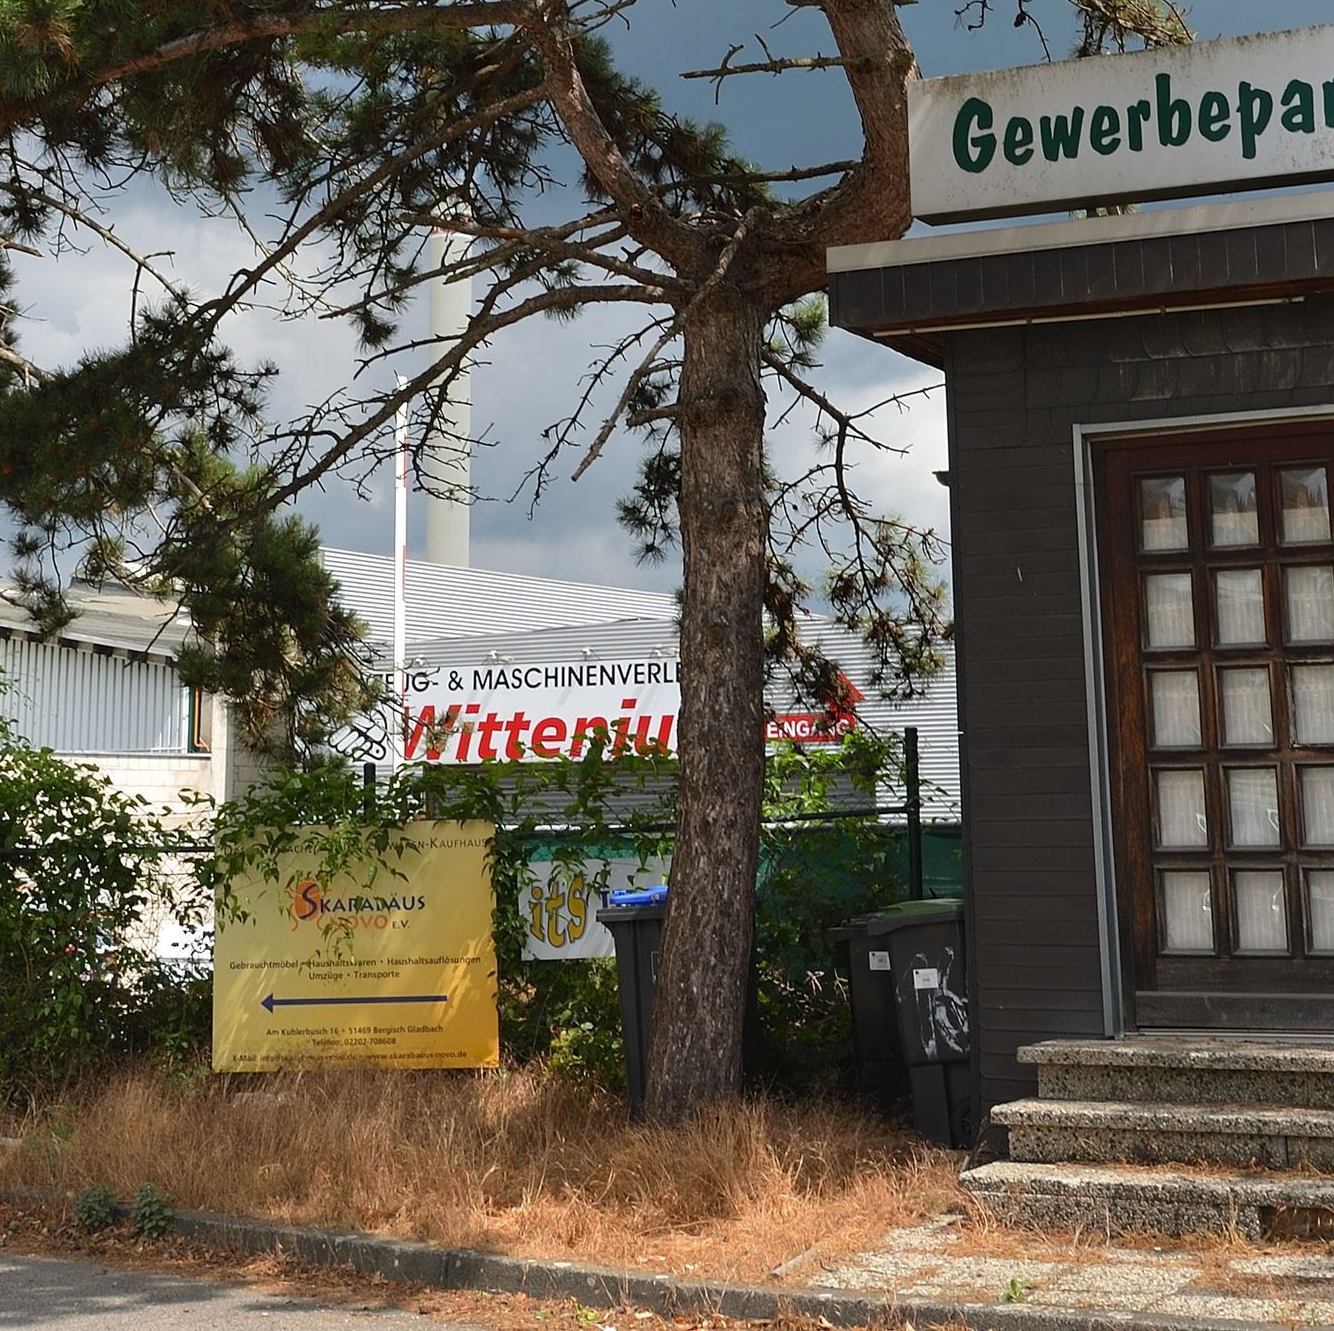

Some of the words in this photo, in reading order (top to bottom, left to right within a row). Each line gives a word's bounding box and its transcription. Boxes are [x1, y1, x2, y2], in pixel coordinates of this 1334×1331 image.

[448, 671, 464, 691] &
[402, 698, 679, 761] Witteniu
[354, 970, 401, 980] Transporte
[266, 1028, 280, 1036] Am
[330, 1027, 339, 1035] 16
[349, 1026, 371, 1035] 51469
[373, 1025, 406, 1036] Bergisch
[407, 1024, 444, 1034] Gladbach
